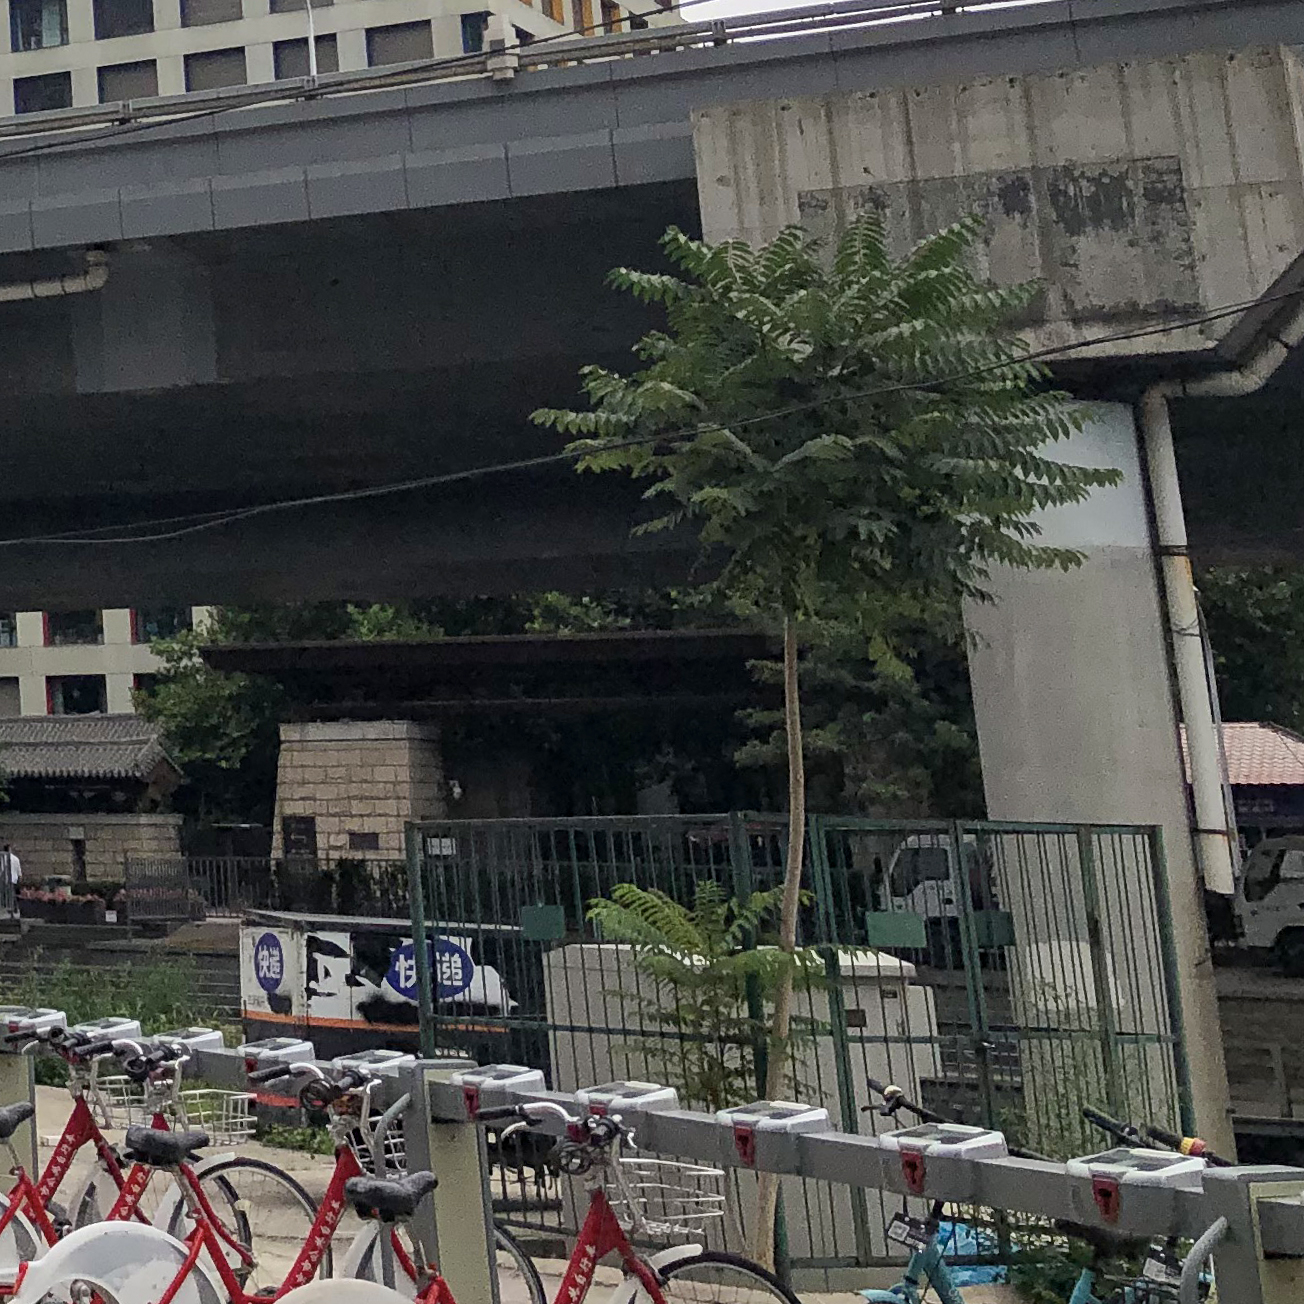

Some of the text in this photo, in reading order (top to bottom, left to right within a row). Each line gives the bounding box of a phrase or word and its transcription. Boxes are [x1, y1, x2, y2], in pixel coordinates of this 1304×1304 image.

[258, 944, 281, 979] 快递
[289, 1199, 341, 1290] 京市公共自行车
